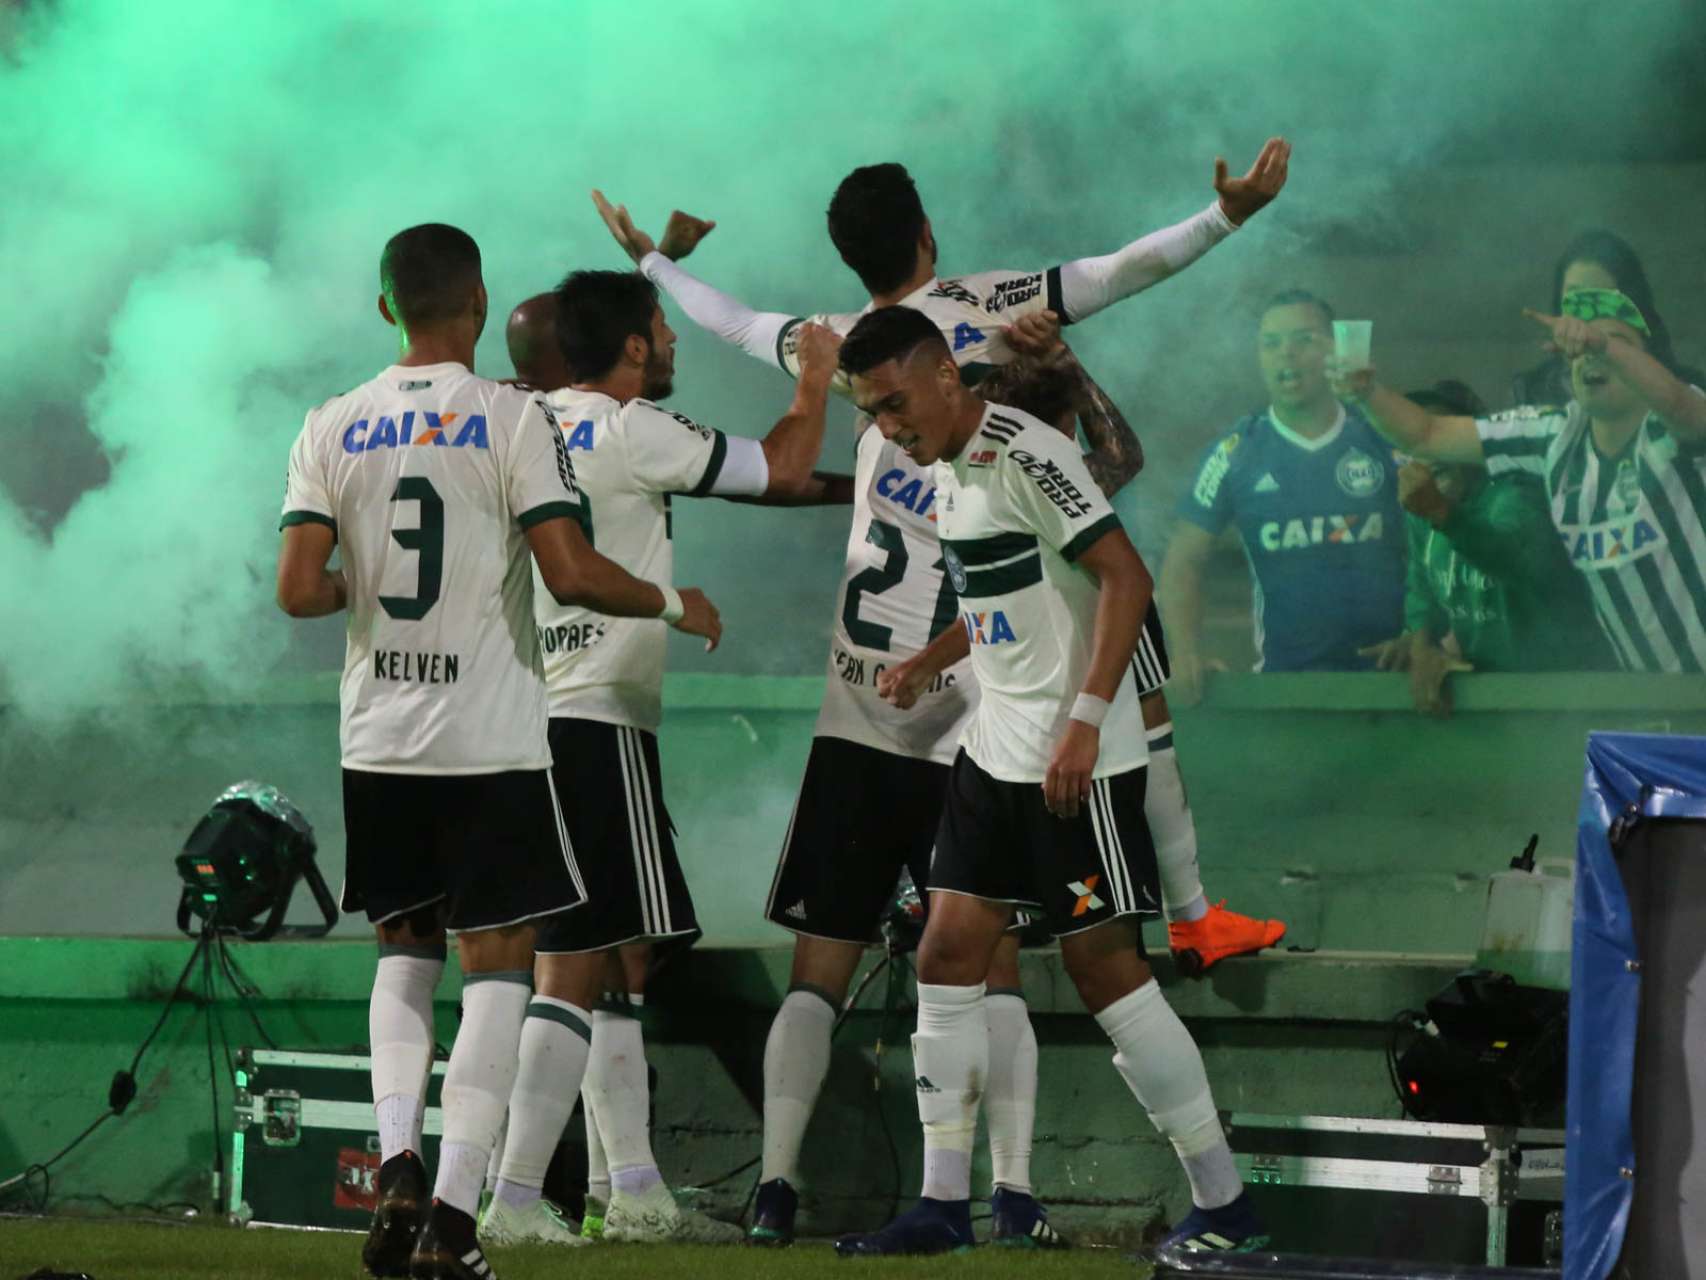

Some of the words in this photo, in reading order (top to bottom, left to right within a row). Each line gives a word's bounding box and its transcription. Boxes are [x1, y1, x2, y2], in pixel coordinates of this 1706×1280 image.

[342, 411, 490, 454] CAIXA
[1036, 477, 1083, 519] PRO
[1038, 458, 1093, 515] TORK
[378, 476, 445, 621] 3
[1259, 512, 1383, 551] CAIXA
[1560, 518, 1659, 561] AIXA
[373, 650, 459, 684] KELVEN
